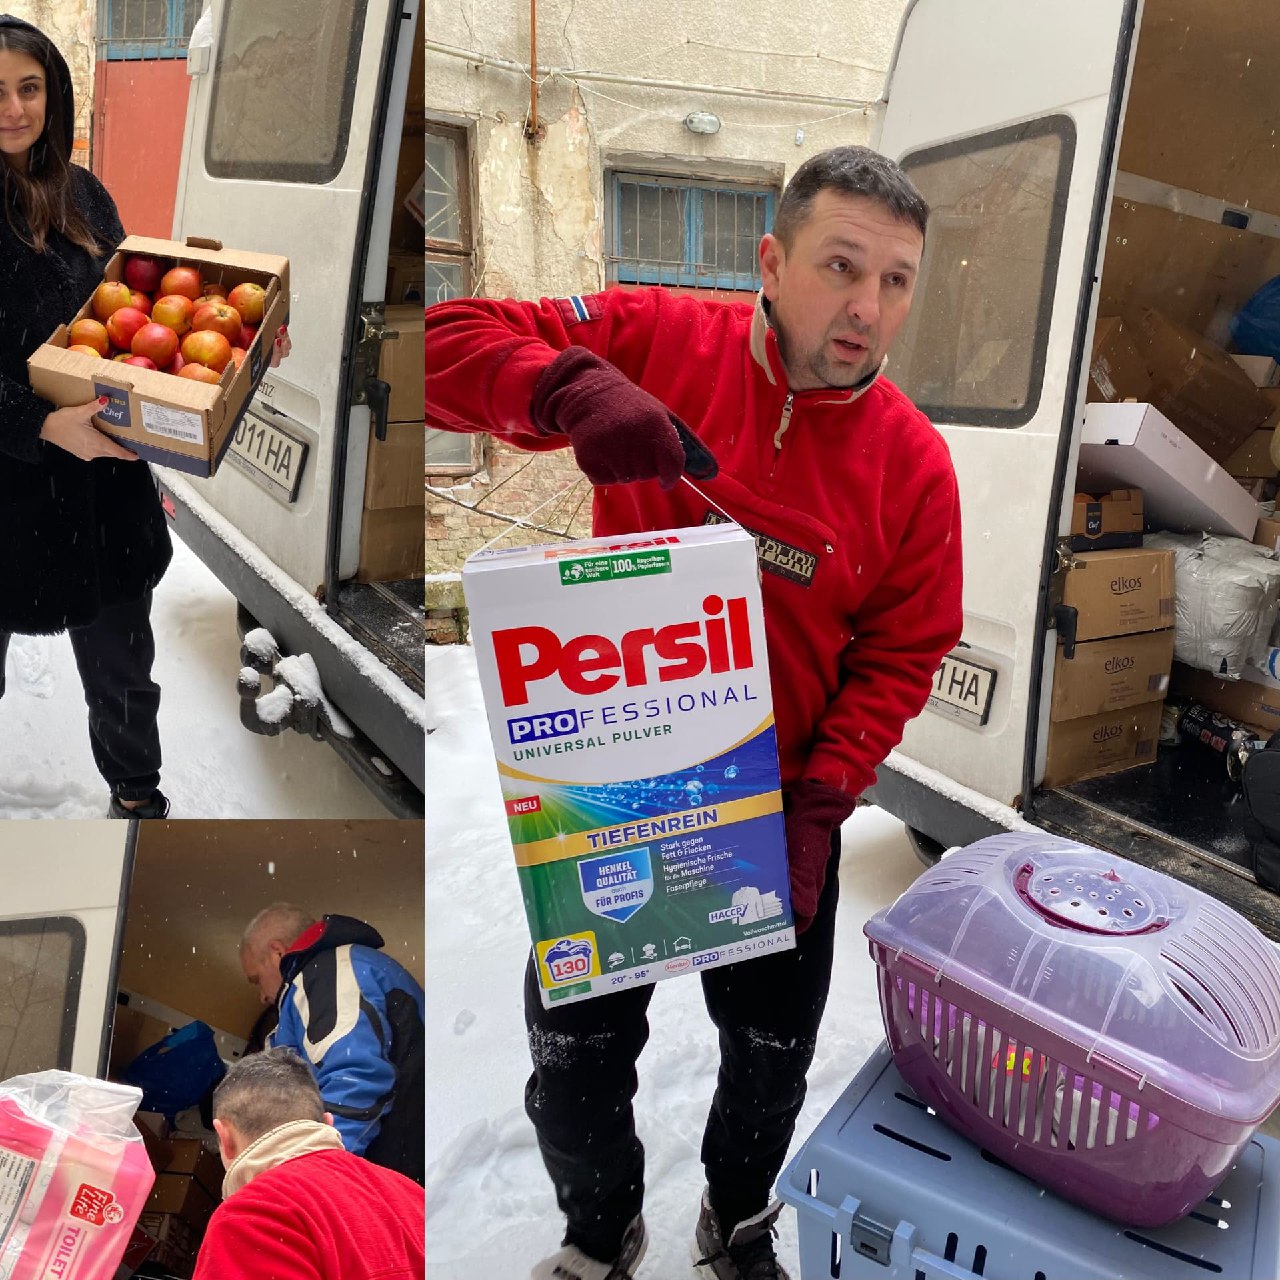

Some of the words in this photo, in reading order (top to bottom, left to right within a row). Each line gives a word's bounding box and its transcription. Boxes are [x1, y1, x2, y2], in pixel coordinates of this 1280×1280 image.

[234, 417, 264, 459] 011
[270, 440, 292, 480] HA
[1110, 575, 1142, 594] elkos
[491, 594, 754, 707] Persil
[1104, 656, 1135, 674] elkos
[508, 684, 758, 742] PROFESSIONAL
[1092, 723, 1123, 742] elkos
[513, 736, 606, 762] UNIVERSAL
[612, 724, 673, 744] PULVER
[513, 799, 538, 813] NEU
[586, 808, 719, 849] TIEFENREIN
[598, 860, 633, 876] HENKEL
[596, 869, 638, 889] QUALITÄT
[596, 893, 612, 908] FÜR
[613, 889, 645, 904] PROFIS
[710, 907, 742, 922] HACCP
[693, 936, 791, 966] PROFESSIONAL
[554, 958, 587, 977] 130
[74, 1187, 90, 1215] Life
[86, 1190, 108, 1222] Fine
